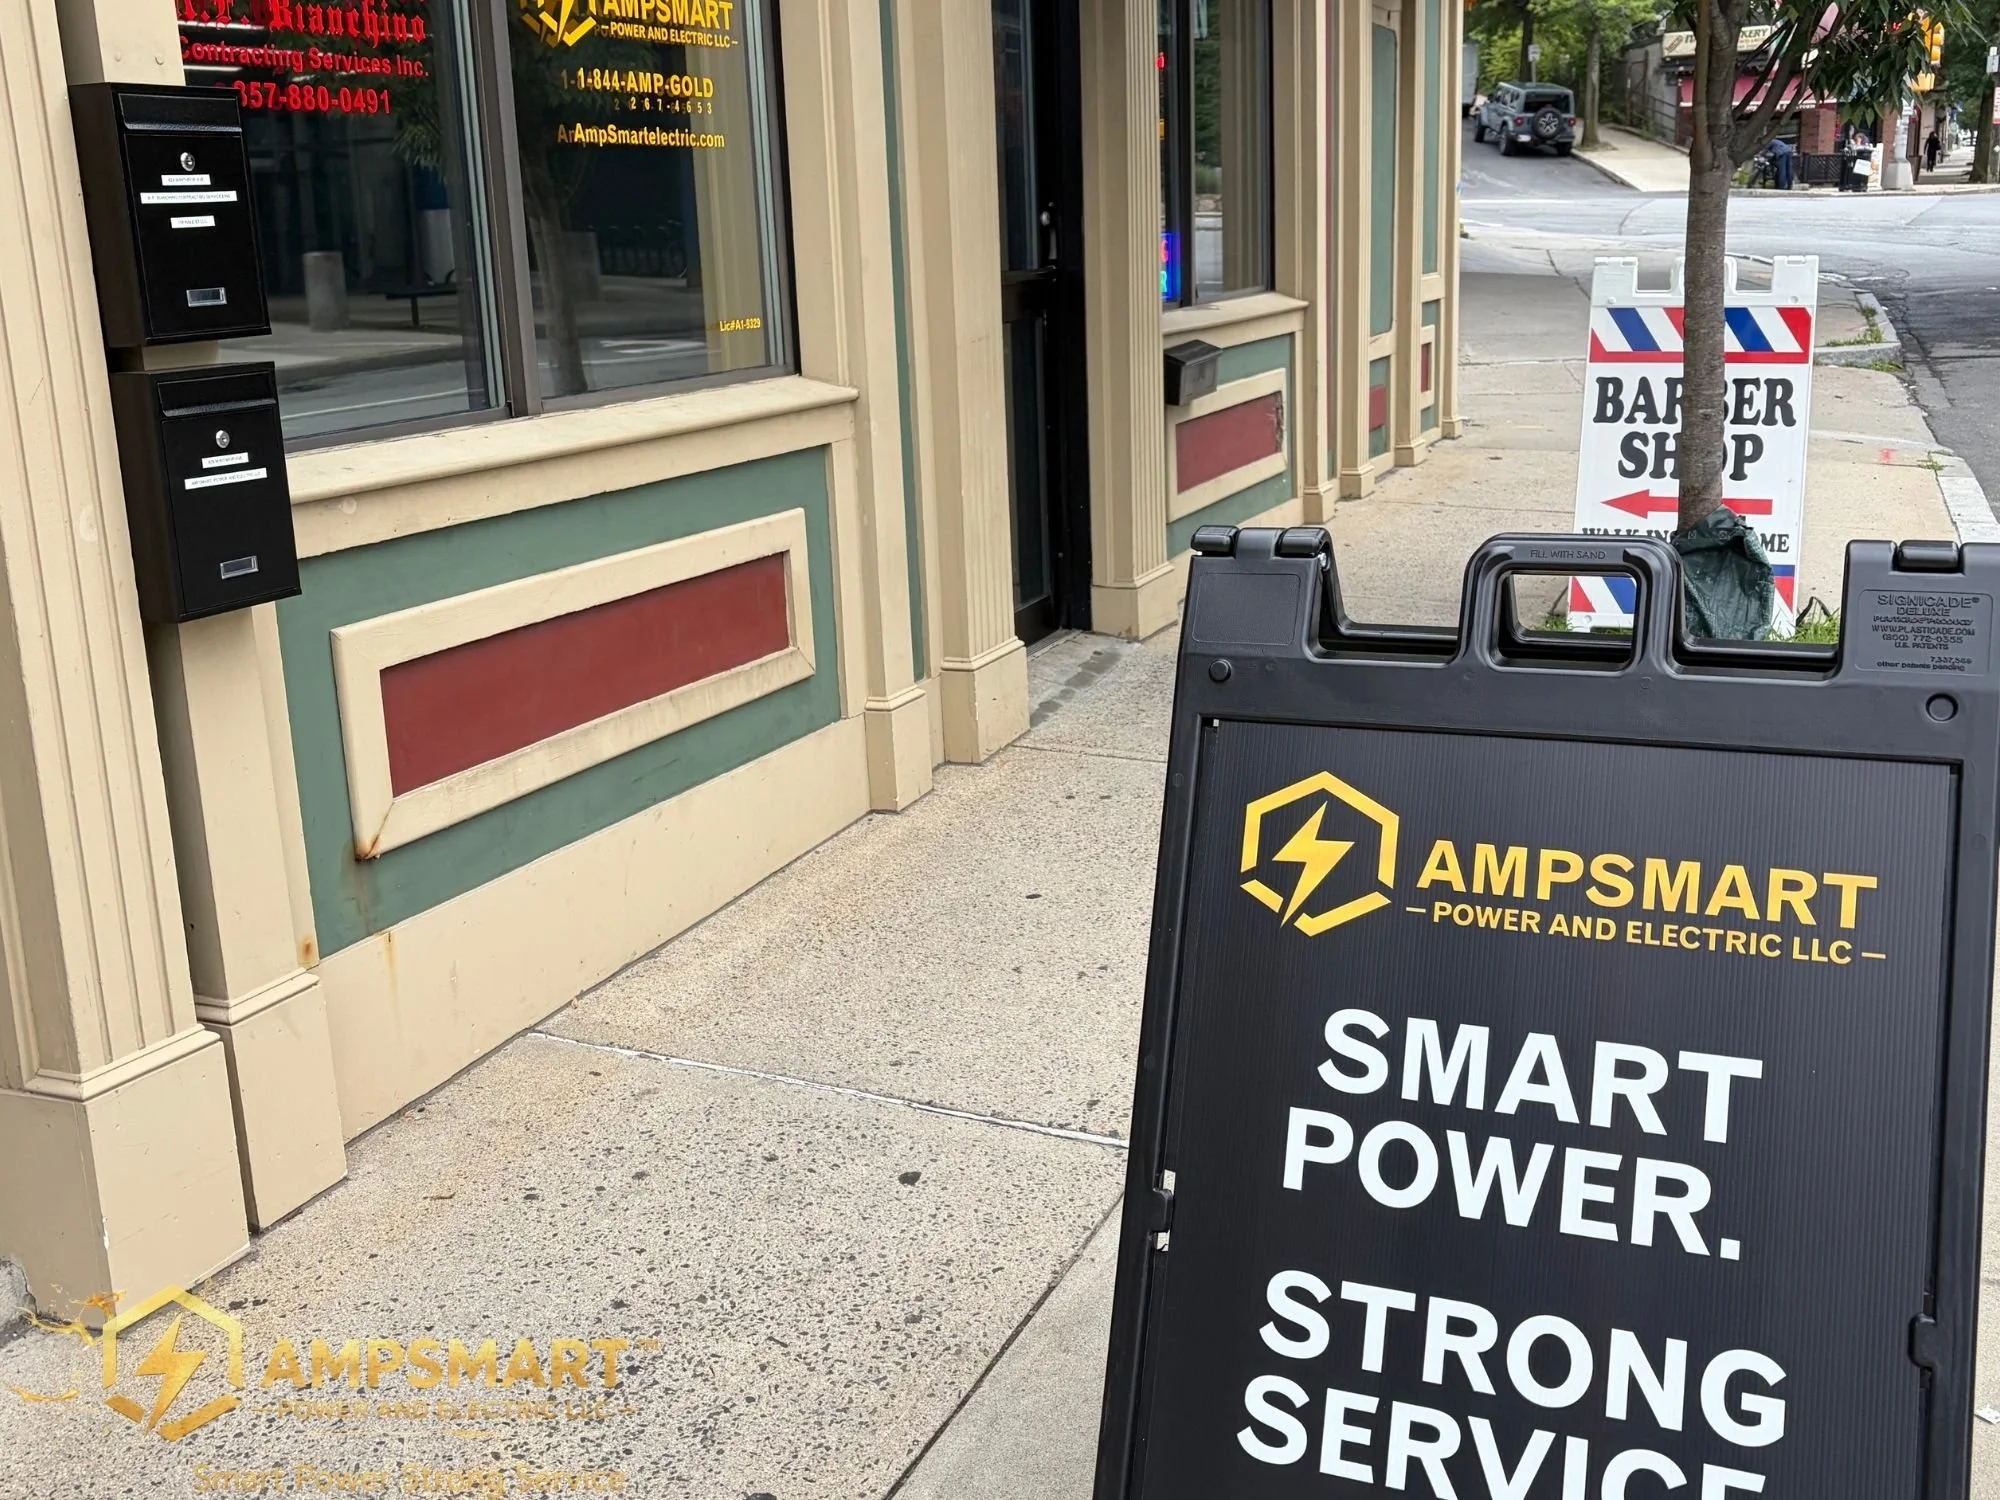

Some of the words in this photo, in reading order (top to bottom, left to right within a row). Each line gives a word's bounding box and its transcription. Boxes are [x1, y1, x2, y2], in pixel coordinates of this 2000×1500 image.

[603, 0, 733, 30] AMPSMART
[610, 21, 645, 38] POWER
[647, 26, 668, 40] AND
[669, 28, 713, 46] ELECTRIC
[714, 34, 731, 48] LLC
[180, 36, 303, 72] Contracting
[308, 47, 391, 74] Services
[396, 54, 429, 77] Inc.
[232, 80, 391, 114] 357-880-0491
[577, 67, 714, 98] 1-844-AMP-GOLD
[574, 122, 725, 148] AmpSmartelectric.com
[1593, 376, 1796, 427] BARER
[1618, 431, 1764, 481] SHP
[1530, 549, 1547, 559] FILL
[1550, 550, 1574, 559] WITH
[1576, 551, 1606, 560] SAND
[1896, 607, 1951, 617] DELUXE
[1872, 625, 1976, 636] WWW.PLASTICADE.COM
[1876, 660, 1900, 668] other
[1416, 839, 1877, 929] AMPSMART
[1433, 903, 1540, 934] POWER
[1548, 912, 1615, 940] AND
[1625, 920, 1781, 957] ELECTRIC
[1792, 936, 1851, 965] LLC
[1317, 1008, 1763, 1144] SMART
[1282, 1106, 1741, 1261] POWER.
[1259, 1270, 1787, 1447] STRONG
